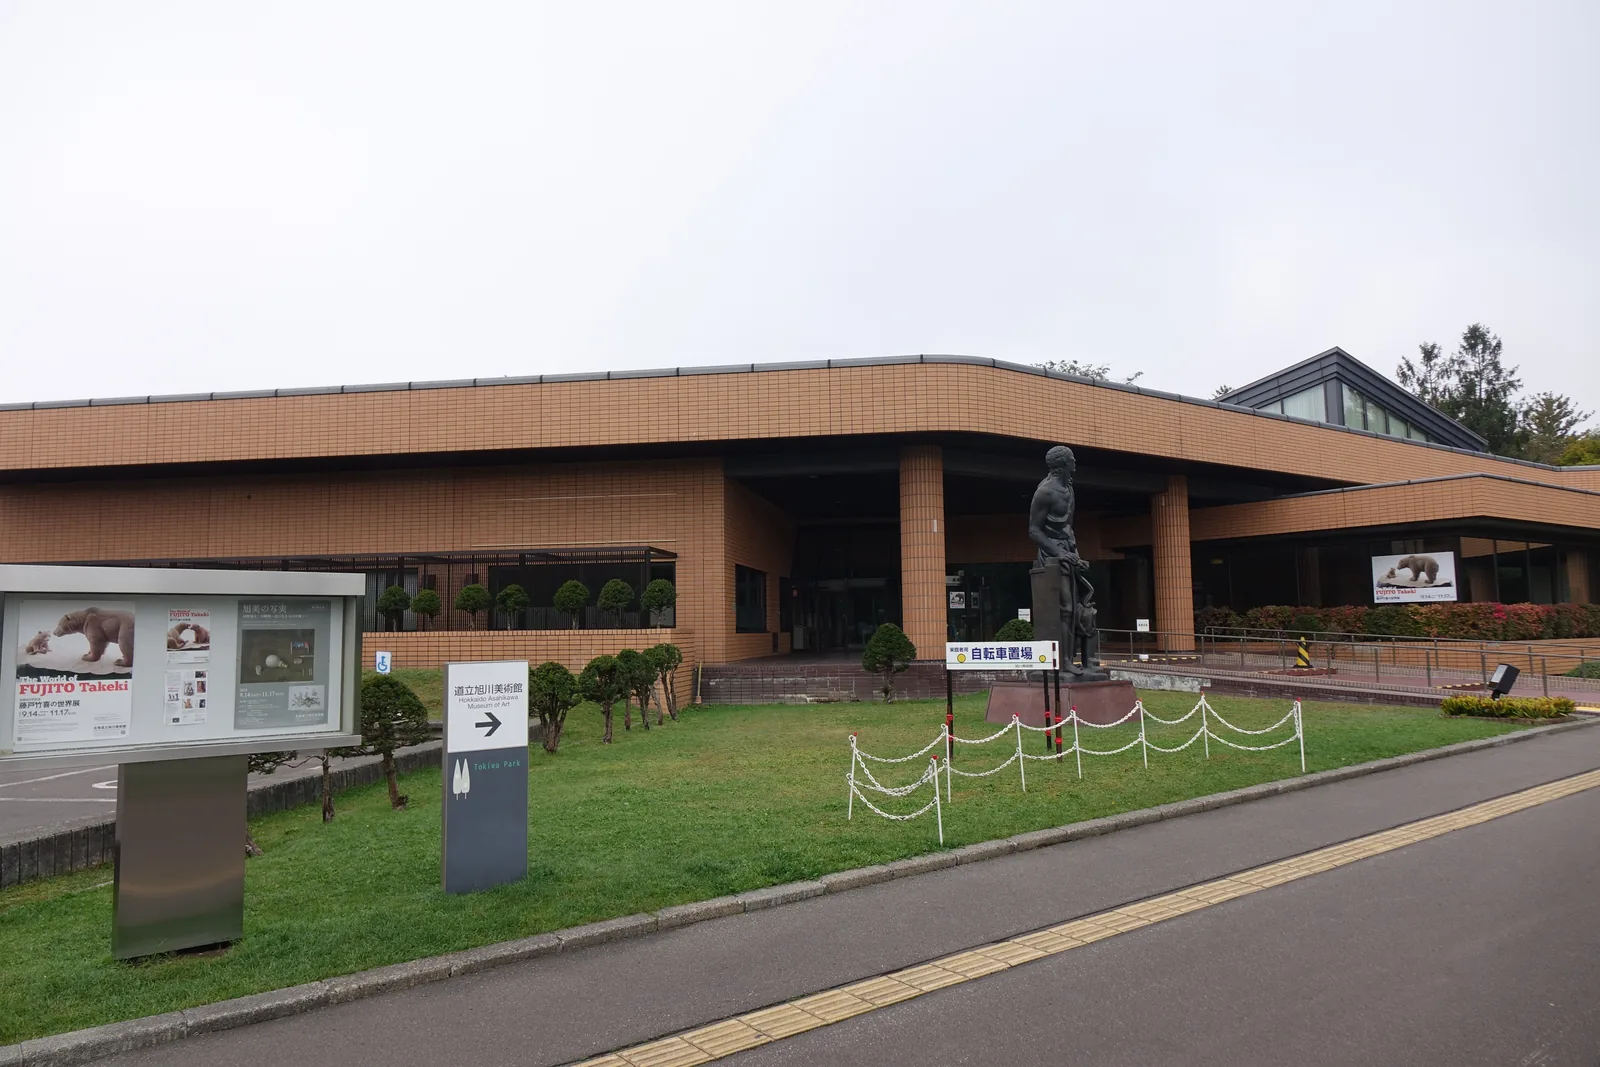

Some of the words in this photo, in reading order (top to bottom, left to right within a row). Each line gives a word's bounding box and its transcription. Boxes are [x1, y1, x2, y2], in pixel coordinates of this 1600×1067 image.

[971, 647, 1033, 660] 自転車置場
[19, 683, 75, 696] FUJITO
[79, 681, 129, 692] Takeki
[454, 683, 523, 696] 道立旭川美術館
[19, 700, 80, 709] 藤戸竹喜の世界展
[473, 763, 500, 771] Tokiwa
[503, 760, 521, 768] Park
